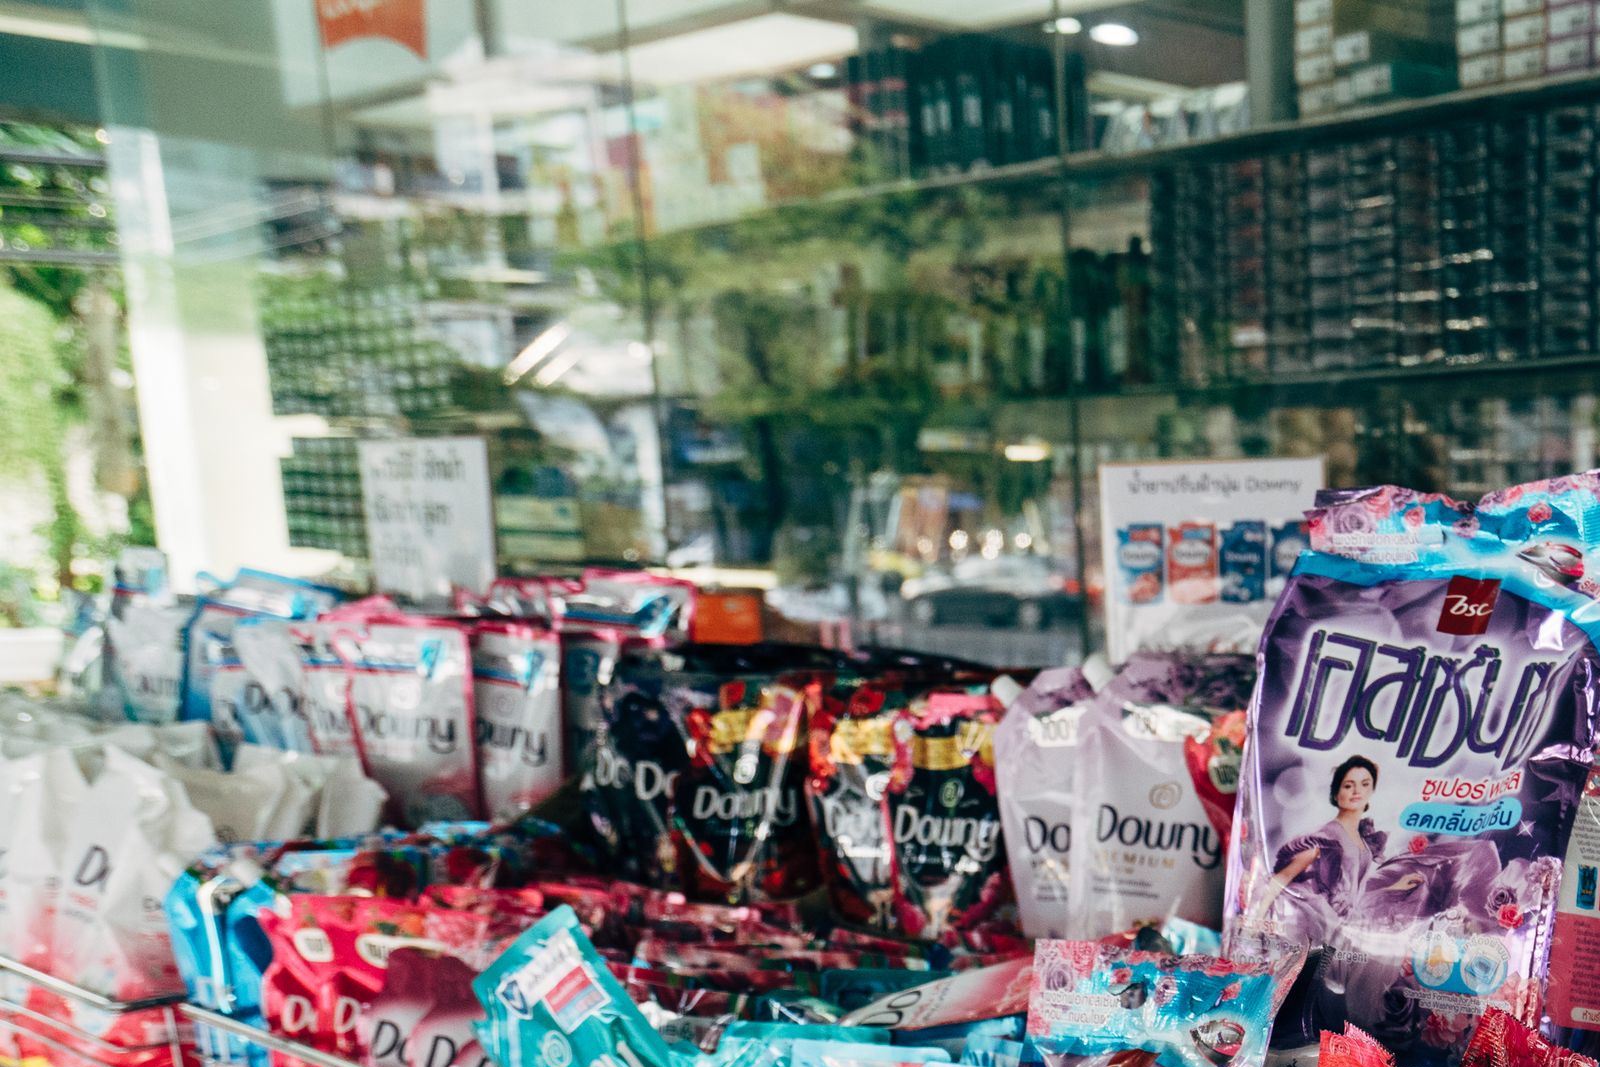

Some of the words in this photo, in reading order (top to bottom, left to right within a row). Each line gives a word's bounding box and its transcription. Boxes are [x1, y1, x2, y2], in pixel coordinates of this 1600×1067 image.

[1245, 478, 1302, 495] Downy
[1446, 594, 1494, 617] bsc
[1285, 629, 1557, 771] เอสเซ้นซ
[476, 714, 548, 767] owny
[692, 785, 797, 827] Downy
[1421, 777, 1486, 802] ซูเปอร์
[896, 803, 999, 861] Downy
[1405, 800, 1514, 833] ลดกลิ่นอับชื้น
[1098, 804, 1222, 870] Downy
[1097, 852, 1175, 869] EMIUM
